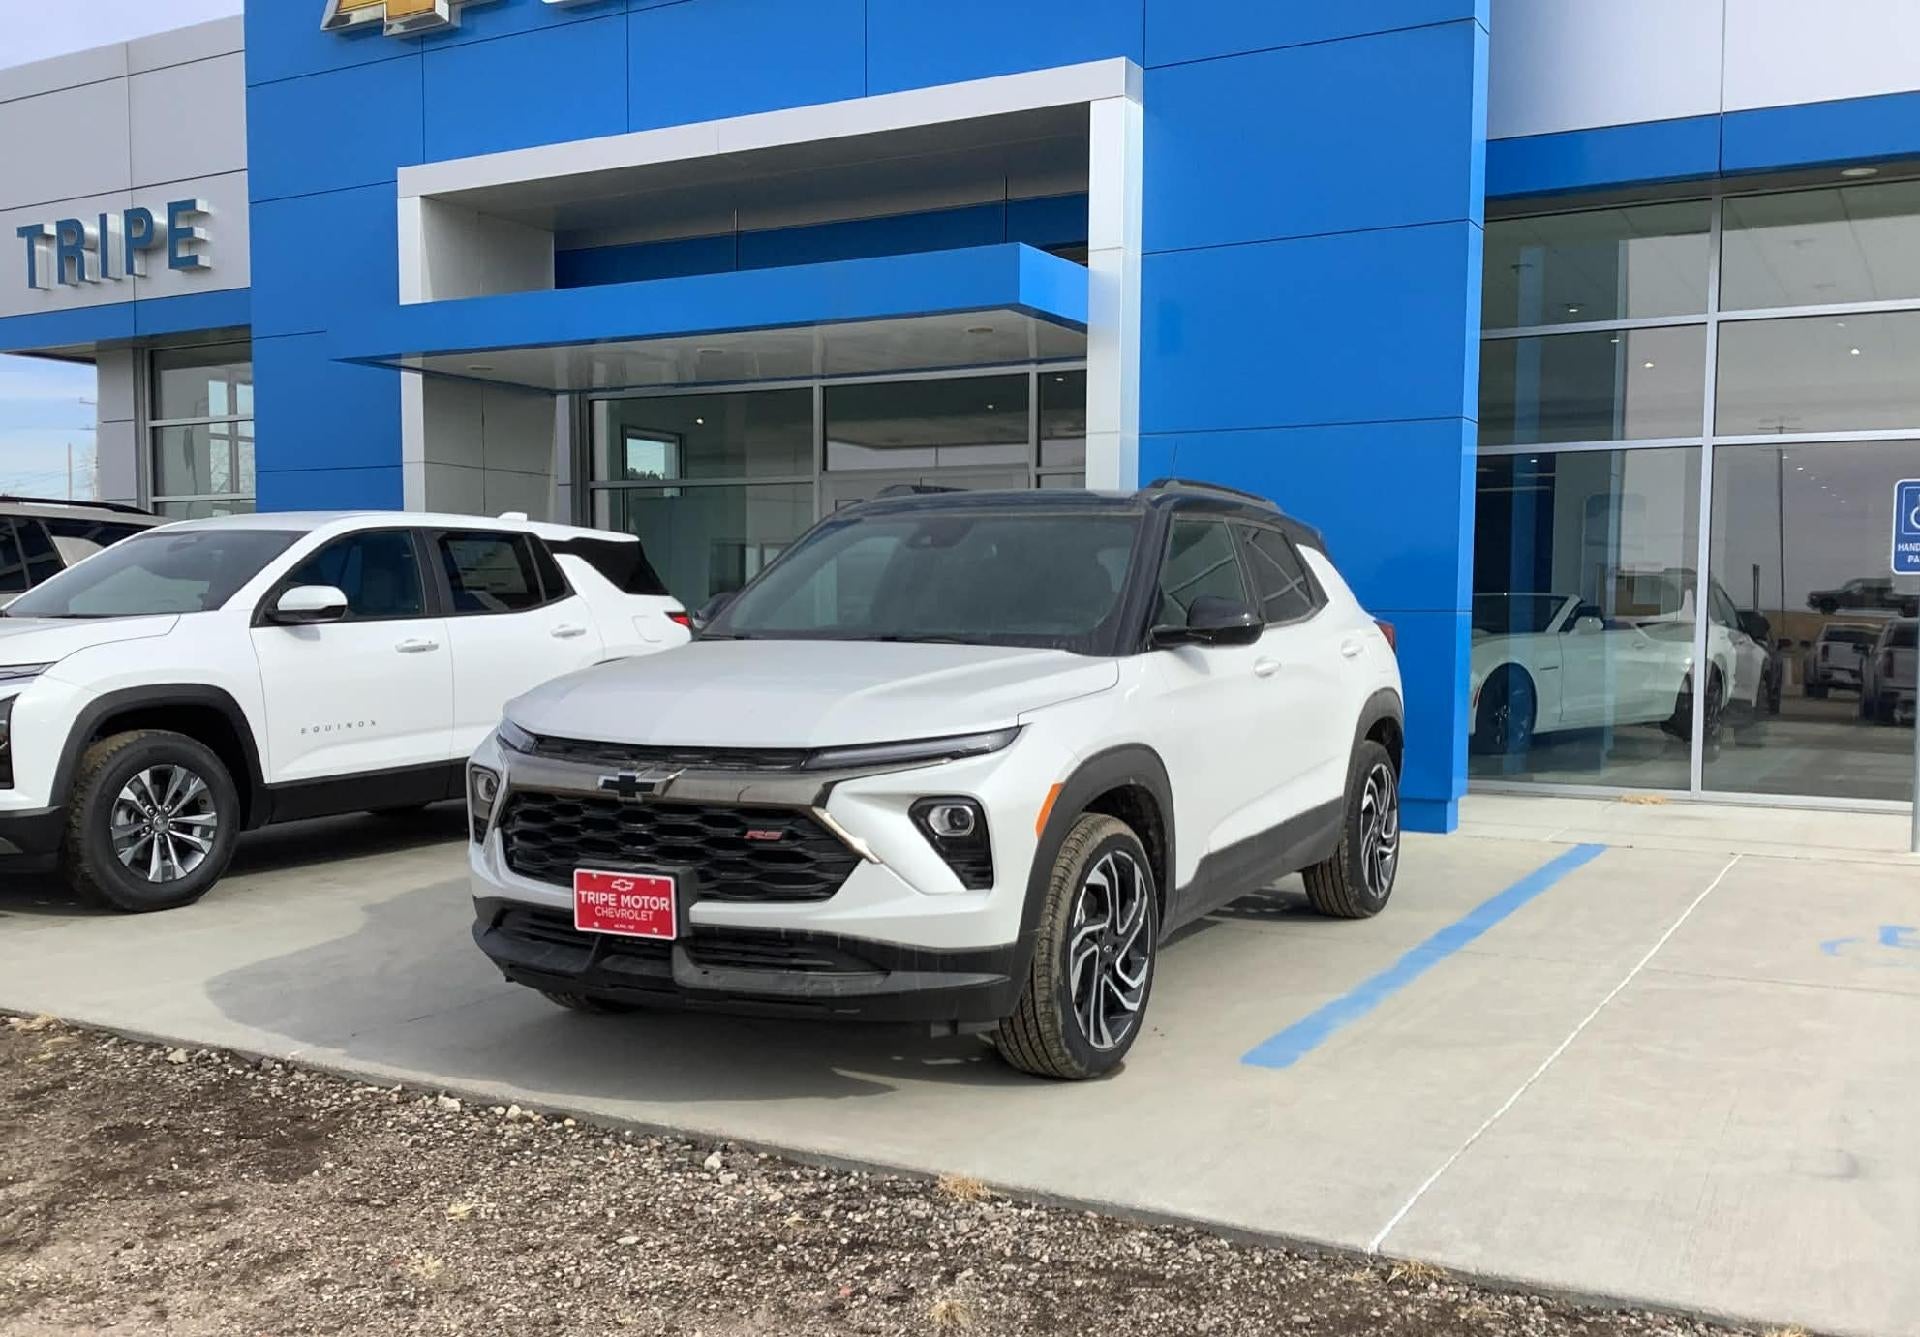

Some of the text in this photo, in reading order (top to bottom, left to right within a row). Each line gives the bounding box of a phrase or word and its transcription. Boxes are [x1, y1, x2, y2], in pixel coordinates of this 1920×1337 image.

[16, 199, 208, 290] TRIPE
[300, 719, 376, 735] EQUINOX
[744, 829, 783, 840] RS
[578, 890, 670, 911] TRIPE MOTOR
[594, 906, 654, 921] CHEVROLET
